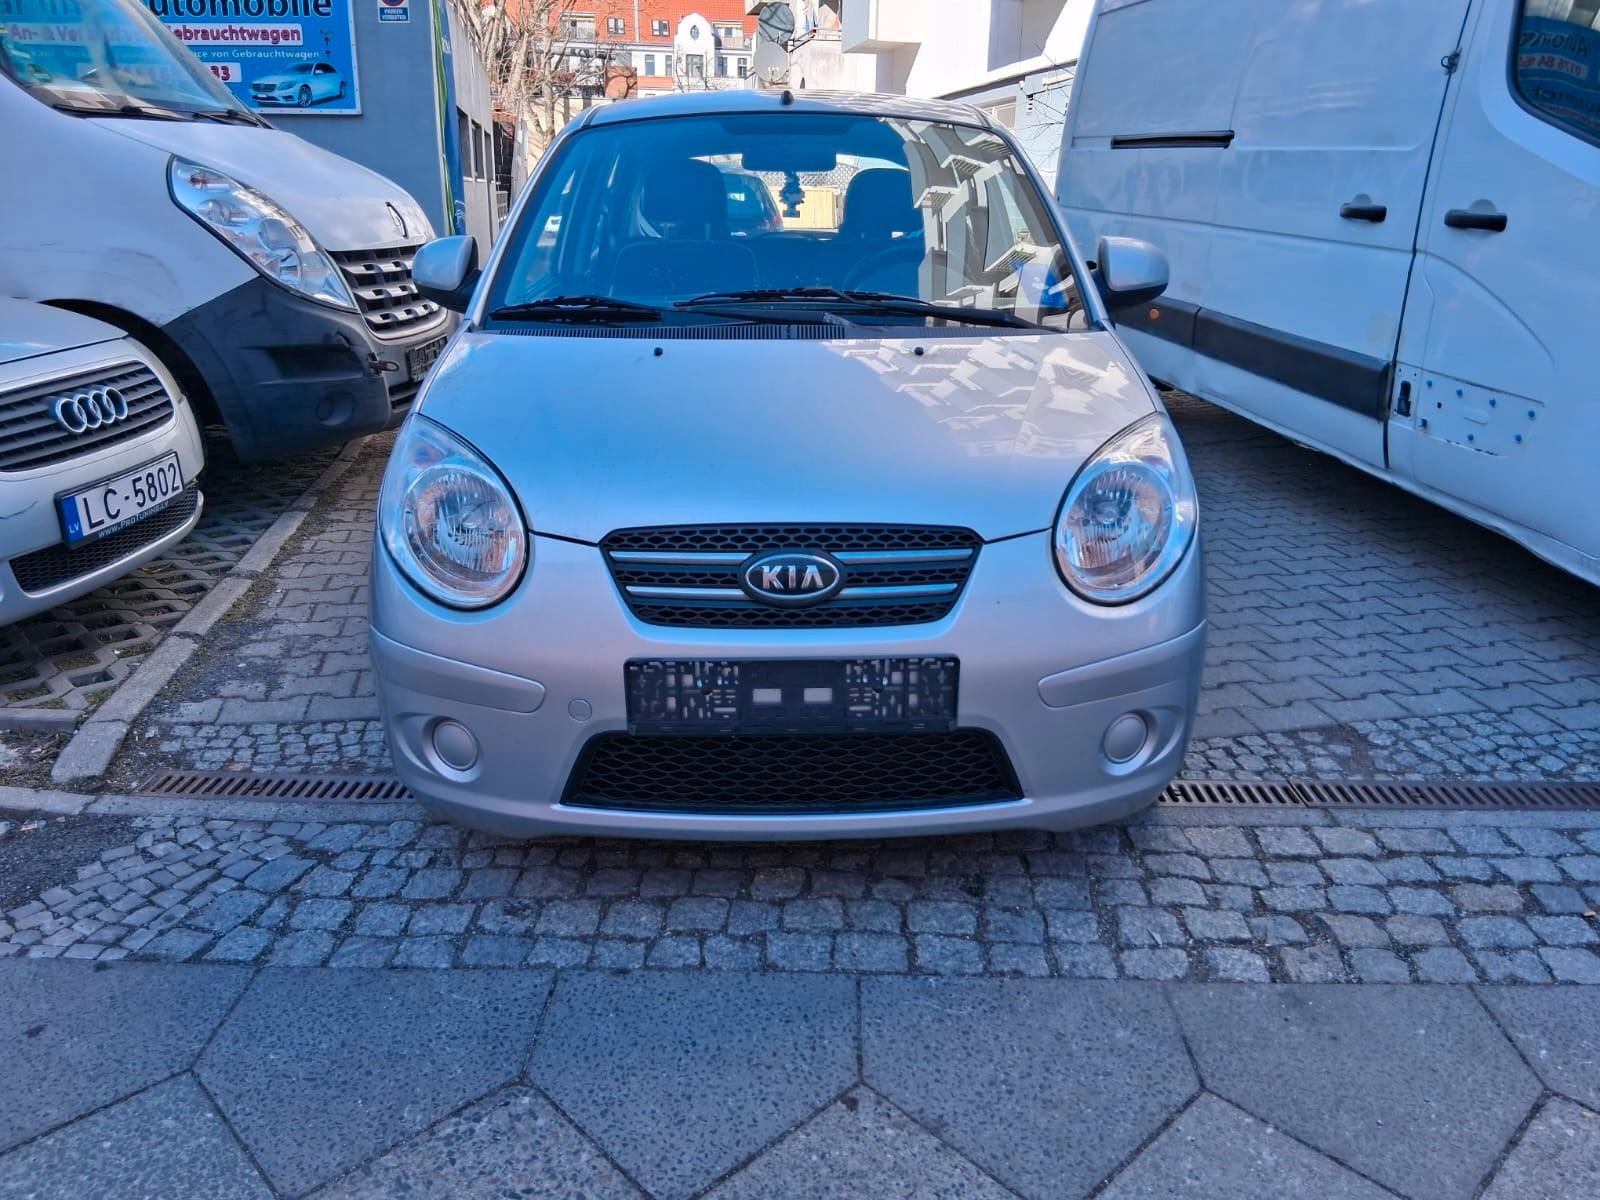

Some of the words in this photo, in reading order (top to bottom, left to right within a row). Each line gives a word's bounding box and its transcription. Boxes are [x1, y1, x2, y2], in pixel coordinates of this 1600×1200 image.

[148, 0, 333, 17] utomobile
[168, 25, 301, 44] ebrauchtwagen
[232, 50, 319, 60] Gebrauchtwagen
[82, 462, 180, 530] LC-5802
[761, 564, 824, 589] KIA
